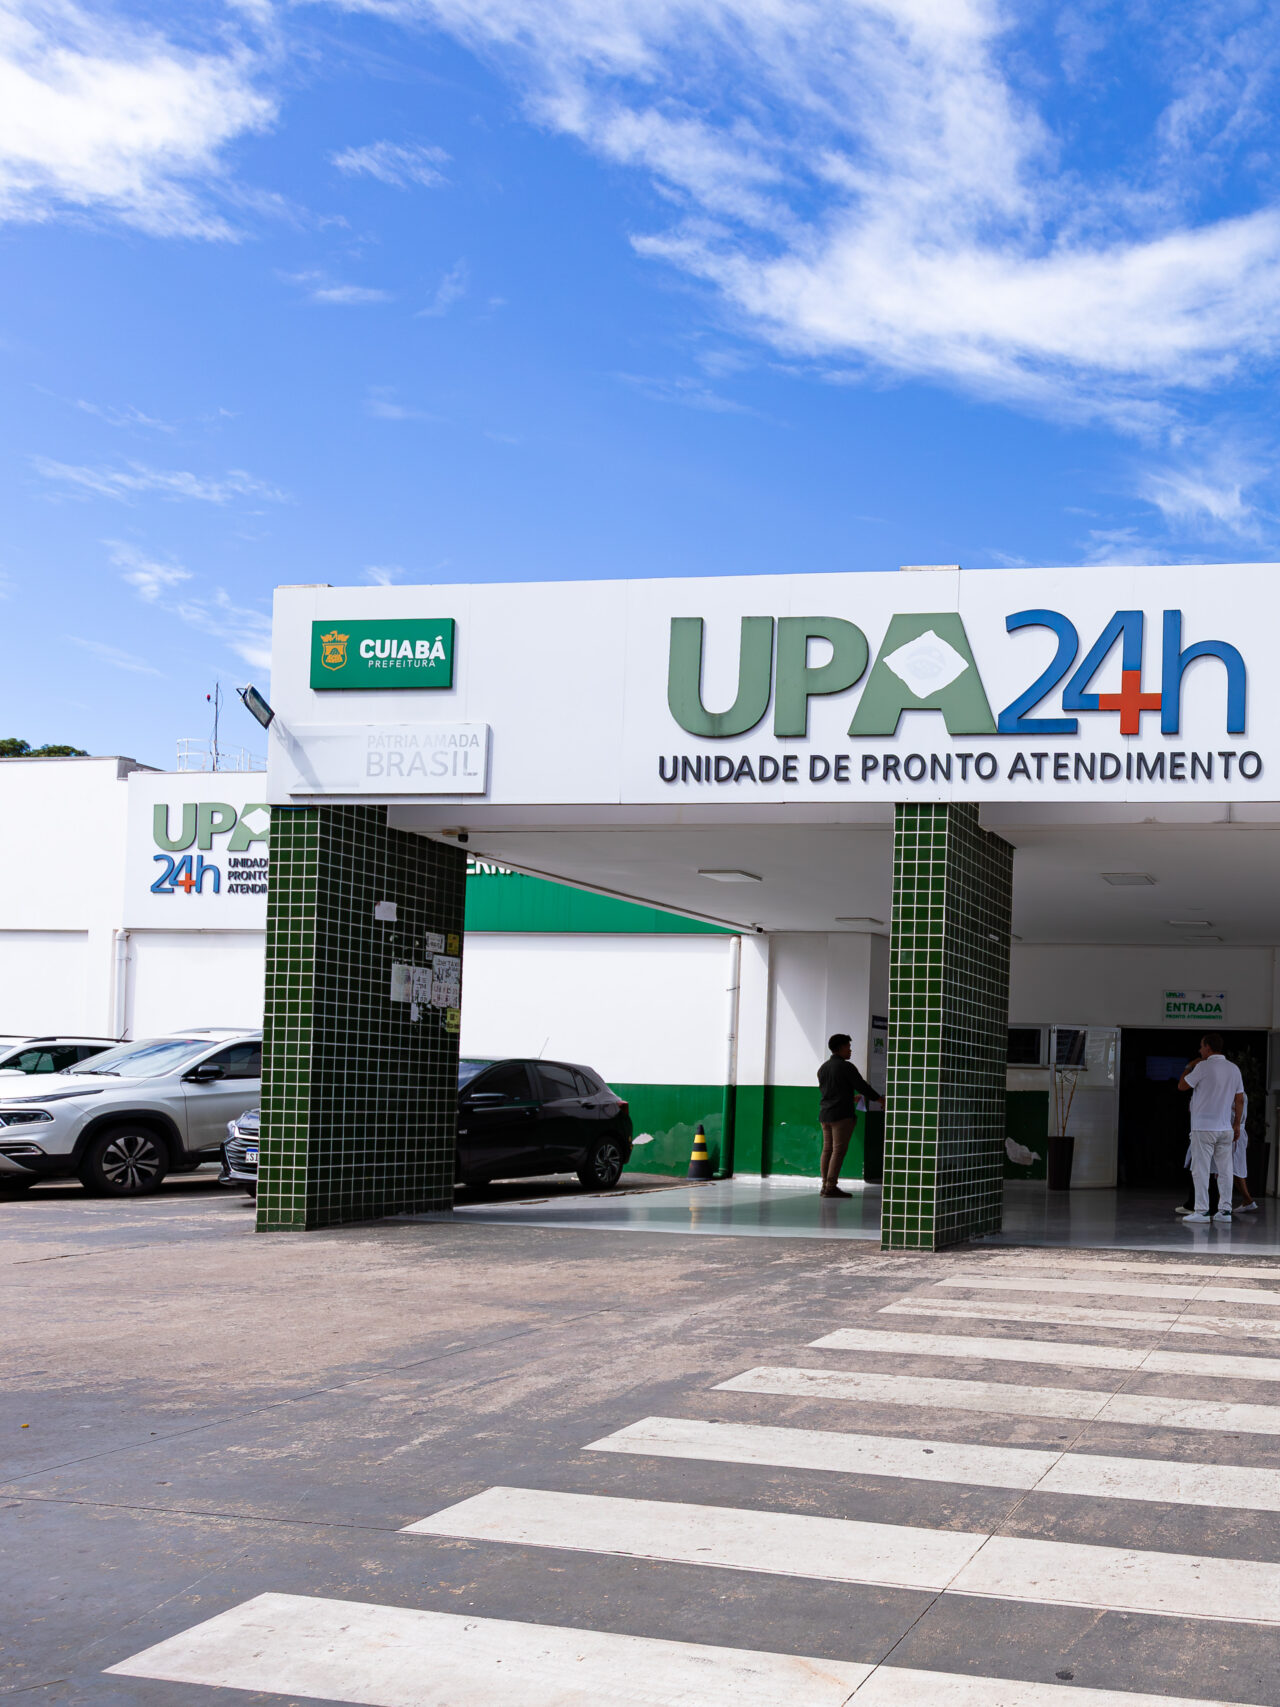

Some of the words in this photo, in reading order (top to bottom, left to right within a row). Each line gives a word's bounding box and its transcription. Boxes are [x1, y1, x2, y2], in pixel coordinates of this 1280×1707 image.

[359, 635, 446, 661] CUIABÁ
[368, 659, 436, 669] PREFEITURA
[667, 612, 999, 739] UPA
[998, 608, 1247, 736] 24h
[367, 731, 419, 748] PÁTRIA
[423, 733, 480, 748] AMADA
[366, 750, 479, 777] BRASIL
[658, 754, 800, 783] UNIDADE
[808, 753, 851, 783] DE
[861, 752, 999, 782] PRONTO
[1007, 750, 1263, 781] ATENDIMENTO
[153, 802, 271, 852] UPA
[150, 853, 221, 894] 24h
[1166, 1002, 1222, 1013] ENTRADA
